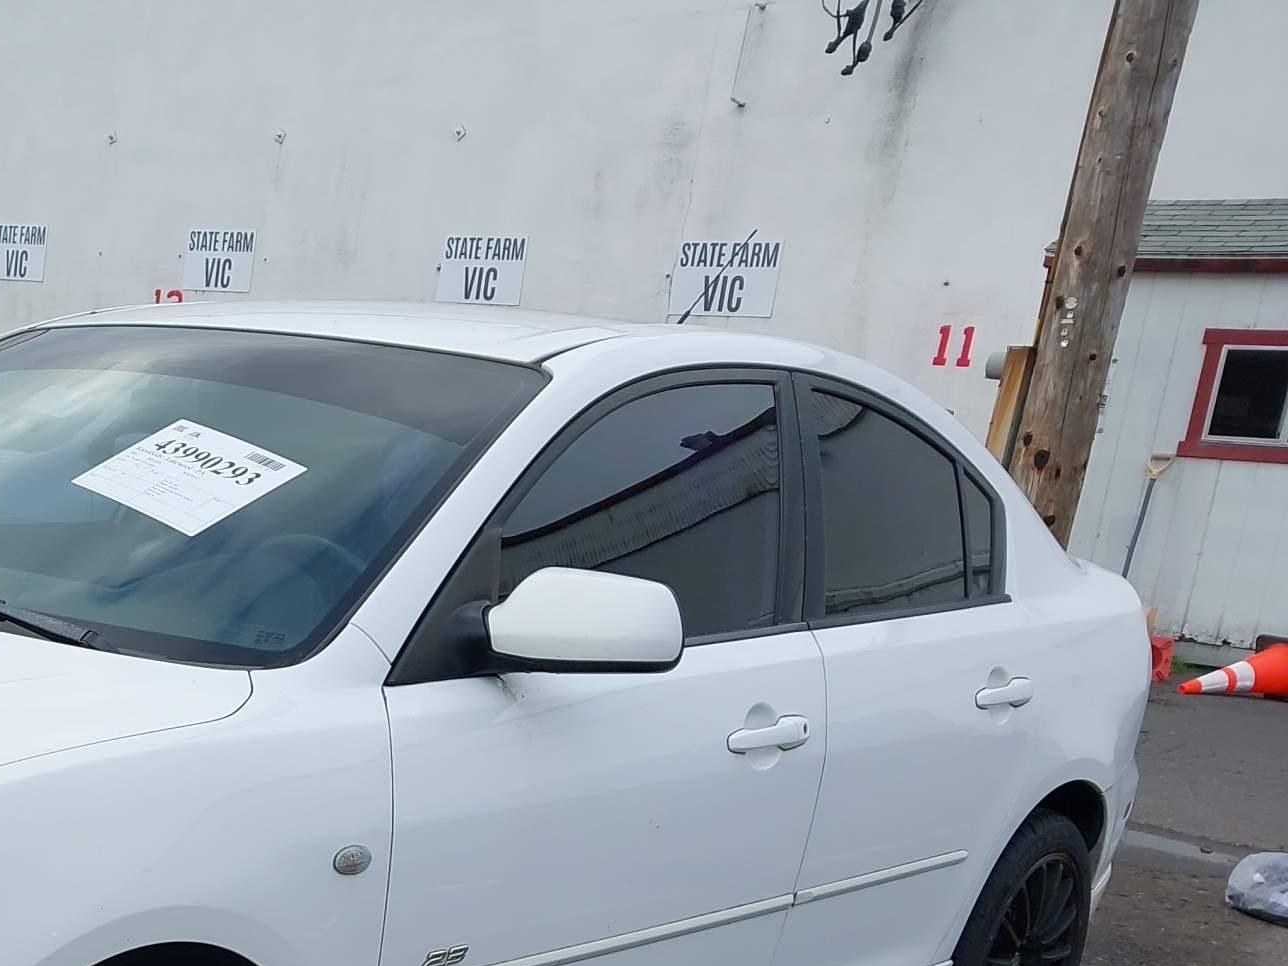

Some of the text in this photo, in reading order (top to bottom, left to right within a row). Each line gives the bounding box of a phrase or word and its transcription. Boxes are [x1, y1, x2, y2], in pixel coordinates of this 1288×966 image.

[20, 226, 46, 245] FARM
[189, 231, 254, 253] STATE FARM
[445, 236, 526, 261] STATE FARM
[6, 250, 28, 278] VIC
[680, 243, 780, 269] STATE FARM
[205, 258, 232, 288] VIC
[464, 267, 498, 301] VIC
[703, 275, 744, 312] VIC
[932, 325, 976, 367] 11
[154, 439, 261, 487] 43990293
